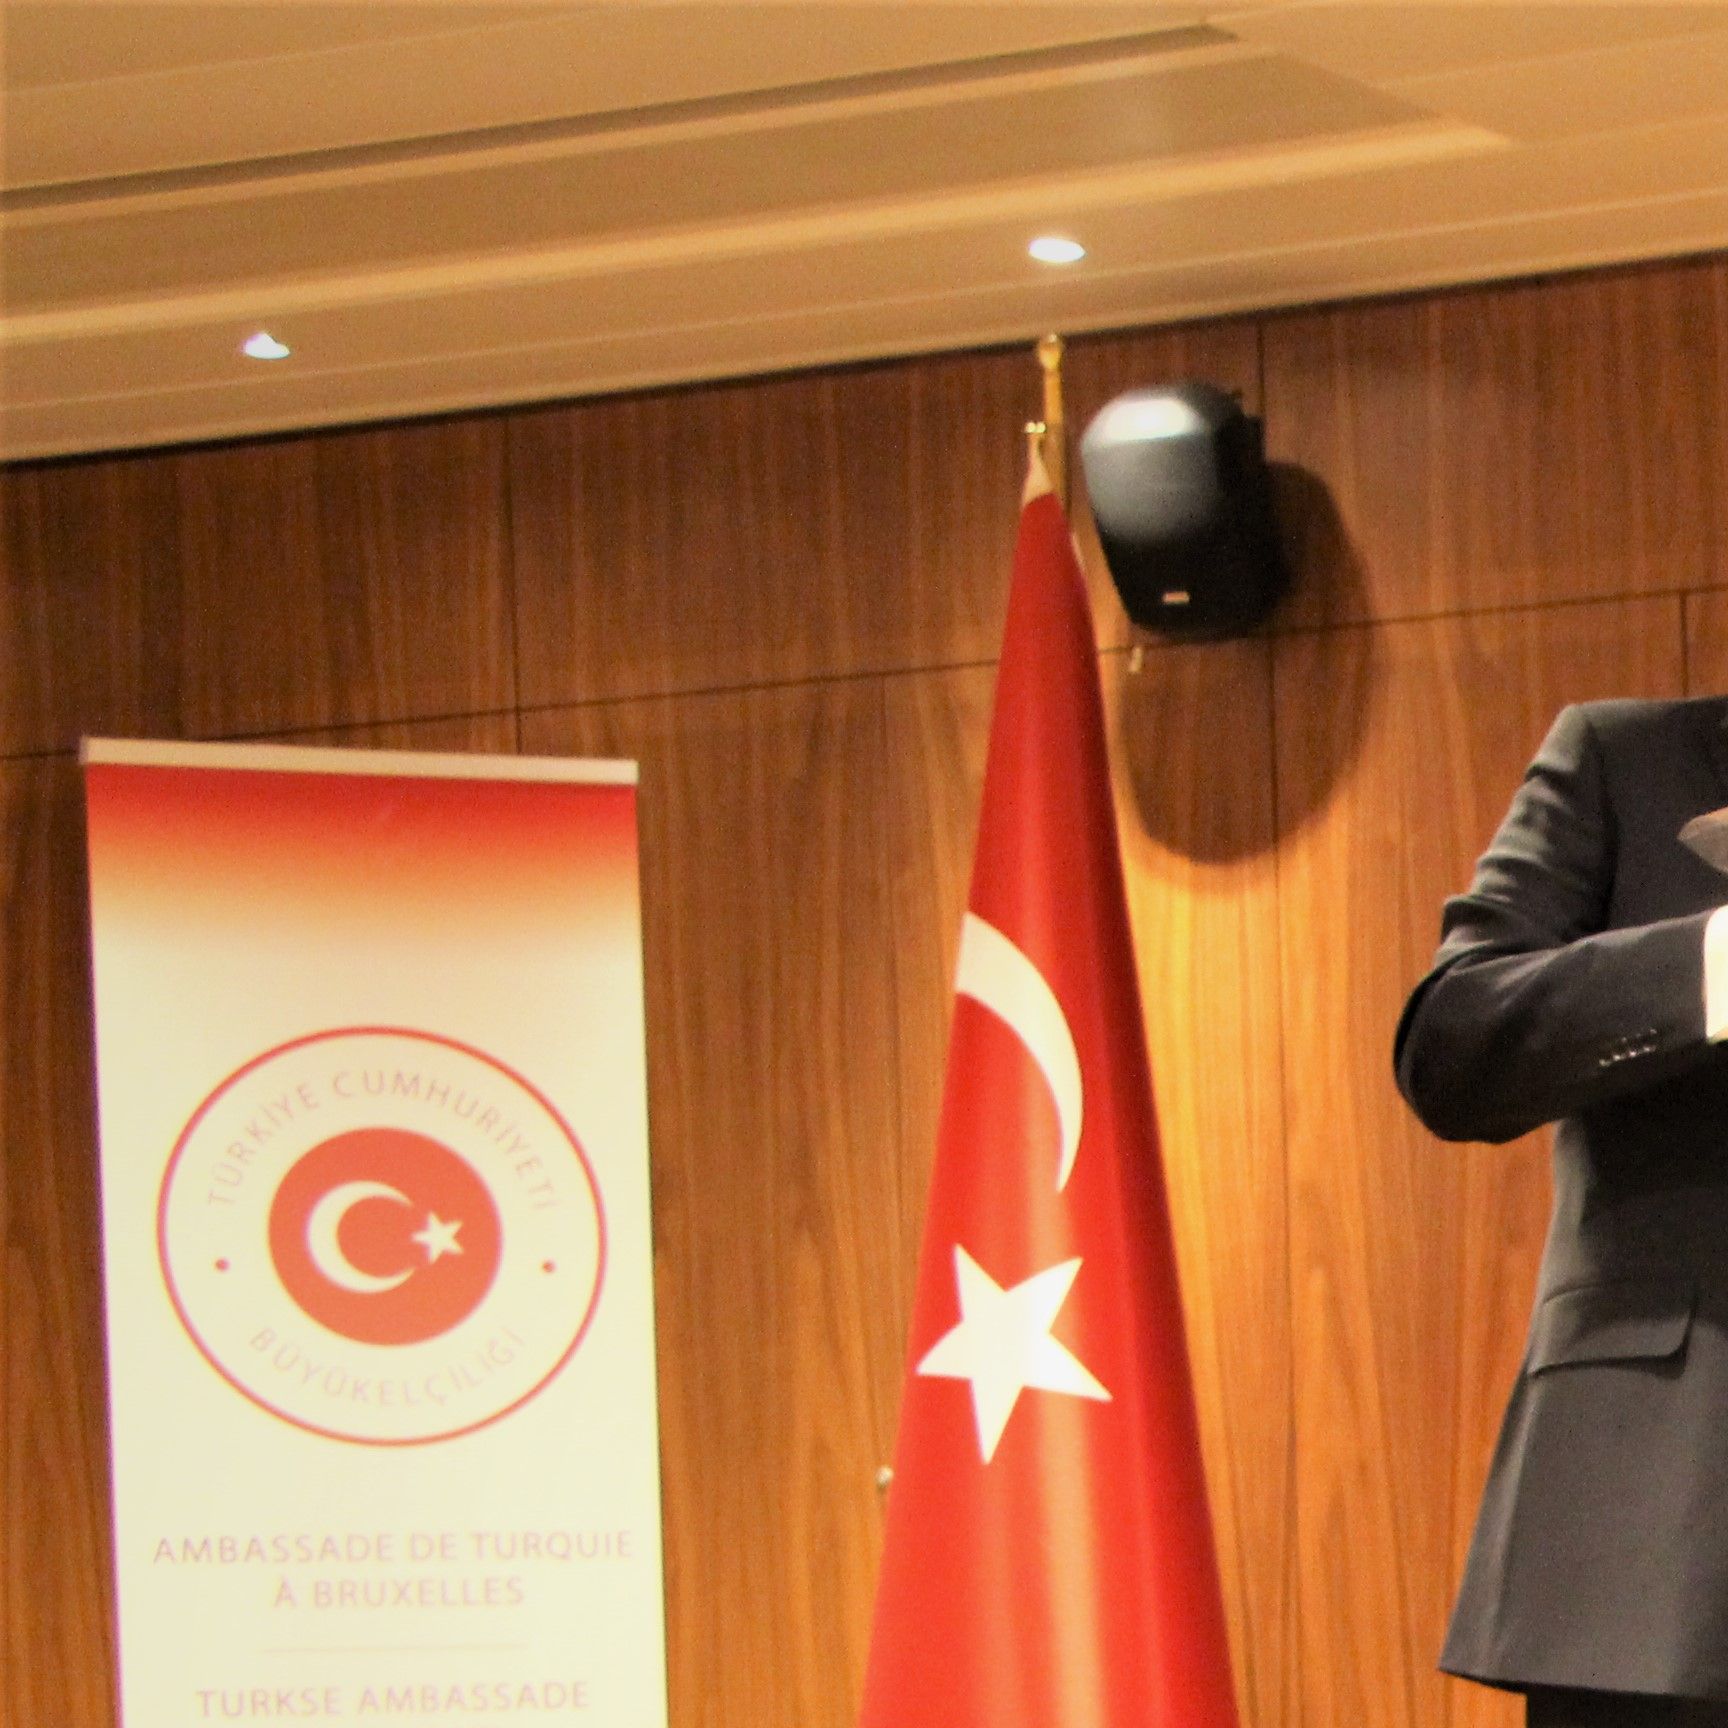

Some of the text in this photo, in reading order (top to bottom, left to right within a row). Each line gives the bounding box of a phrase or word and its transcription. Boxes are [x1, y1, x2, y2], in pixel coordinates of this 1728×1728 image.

[153, 1529, 634, 1564] AMBASSADE DE TURQUIE
[273, 1573, 525, 1609] À BRUXELLES
[196, 1681, 592, 1719] TURKSE AMBASSADE
